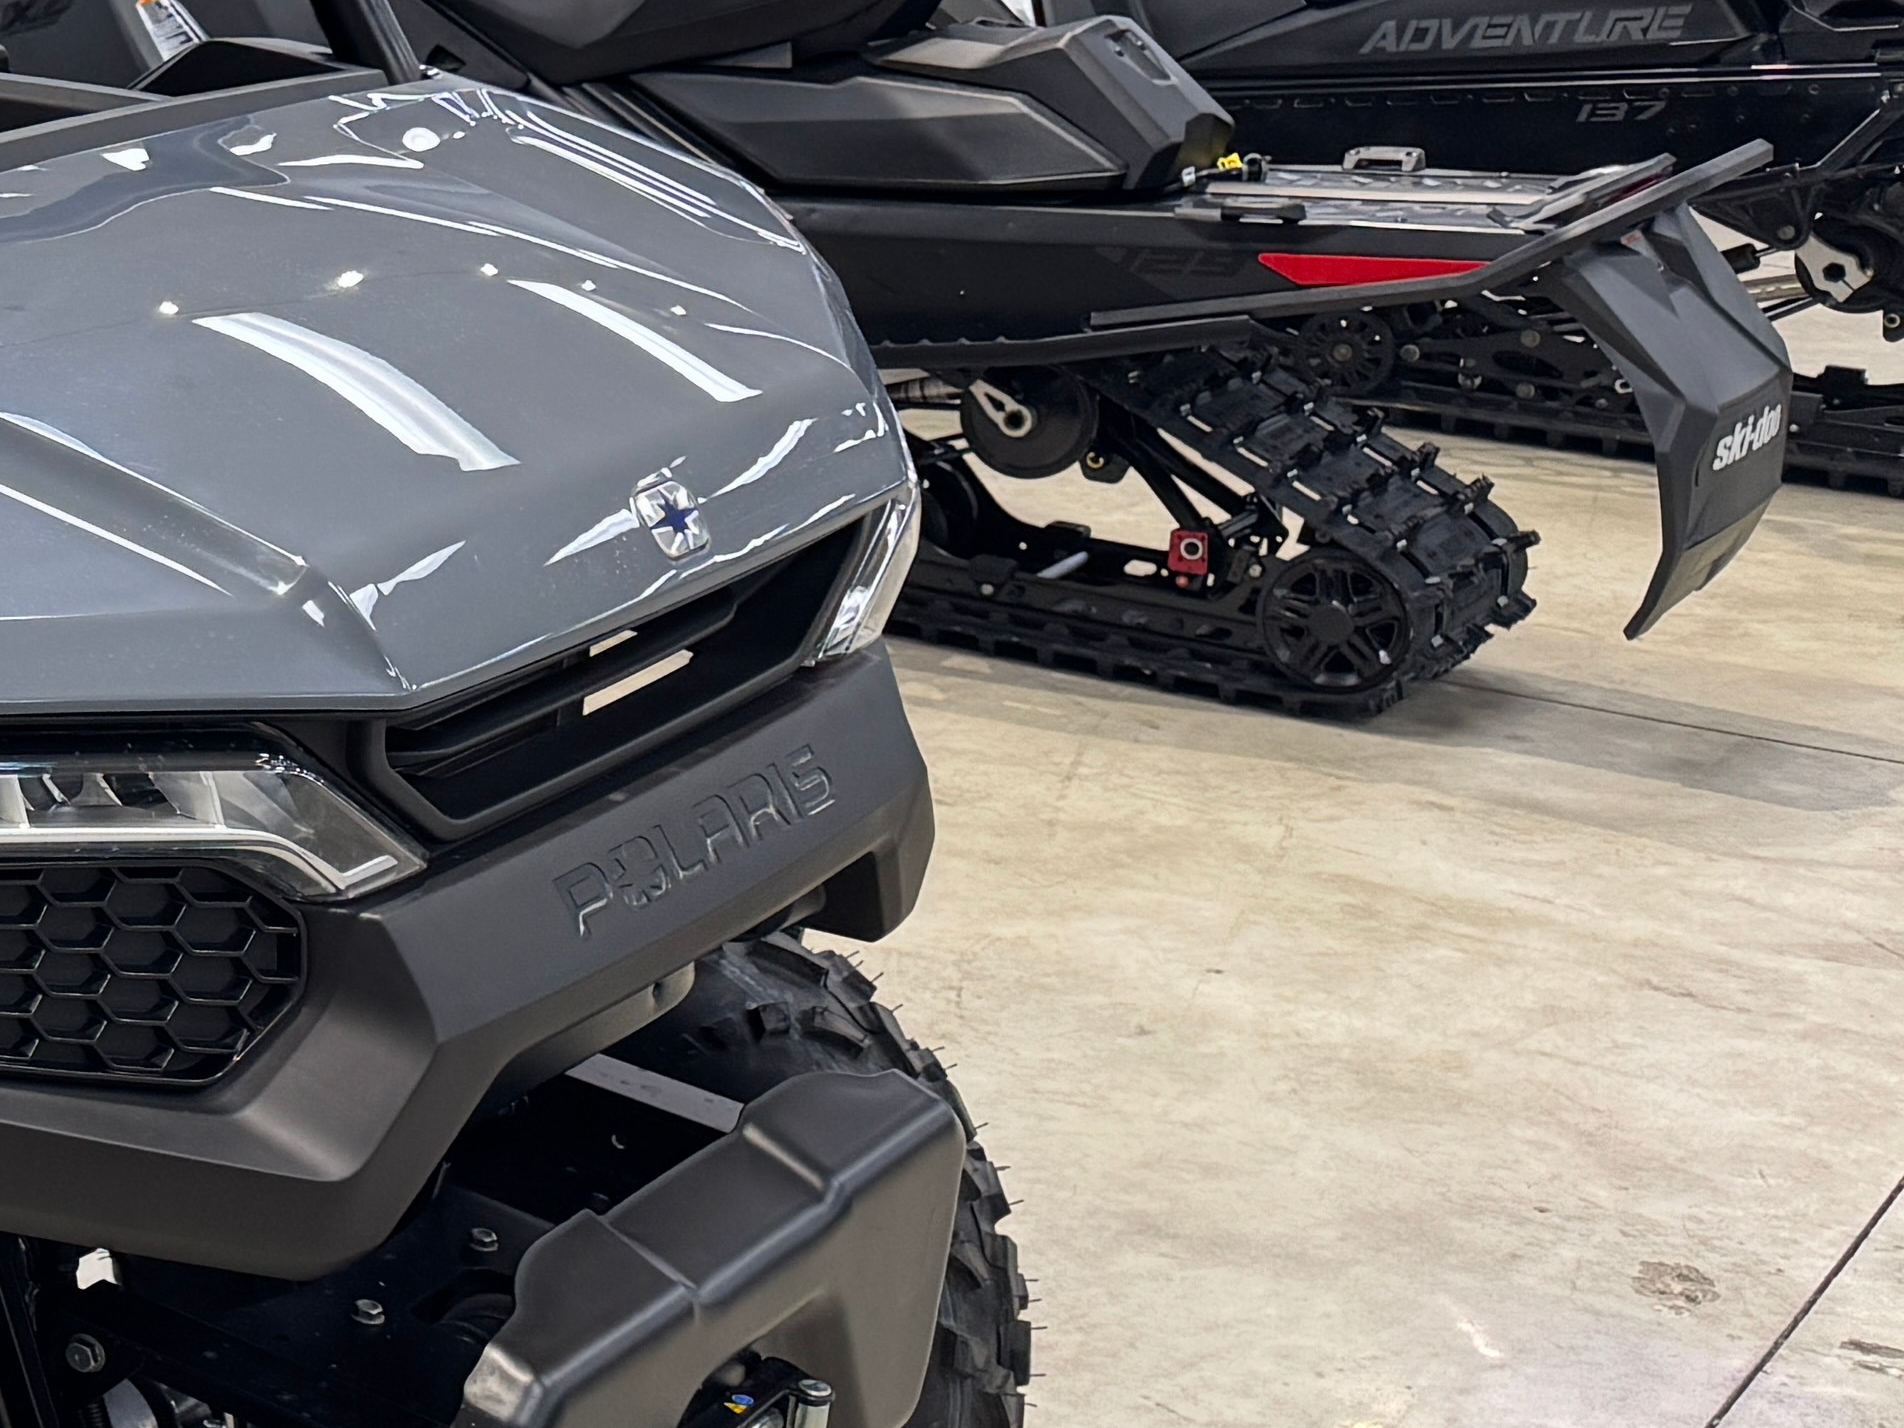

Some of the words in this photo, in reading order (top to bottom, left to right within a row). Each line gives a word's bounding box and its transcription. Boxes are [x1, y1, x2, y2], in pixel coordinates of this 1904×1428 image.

[1359, 3, 1693, 54] ADVENTURE
[1576, 101, 1667, 122] 137
[1712, 403, 1782, 471] ski-doo
[553, 744, 836, 939] POLARIS
